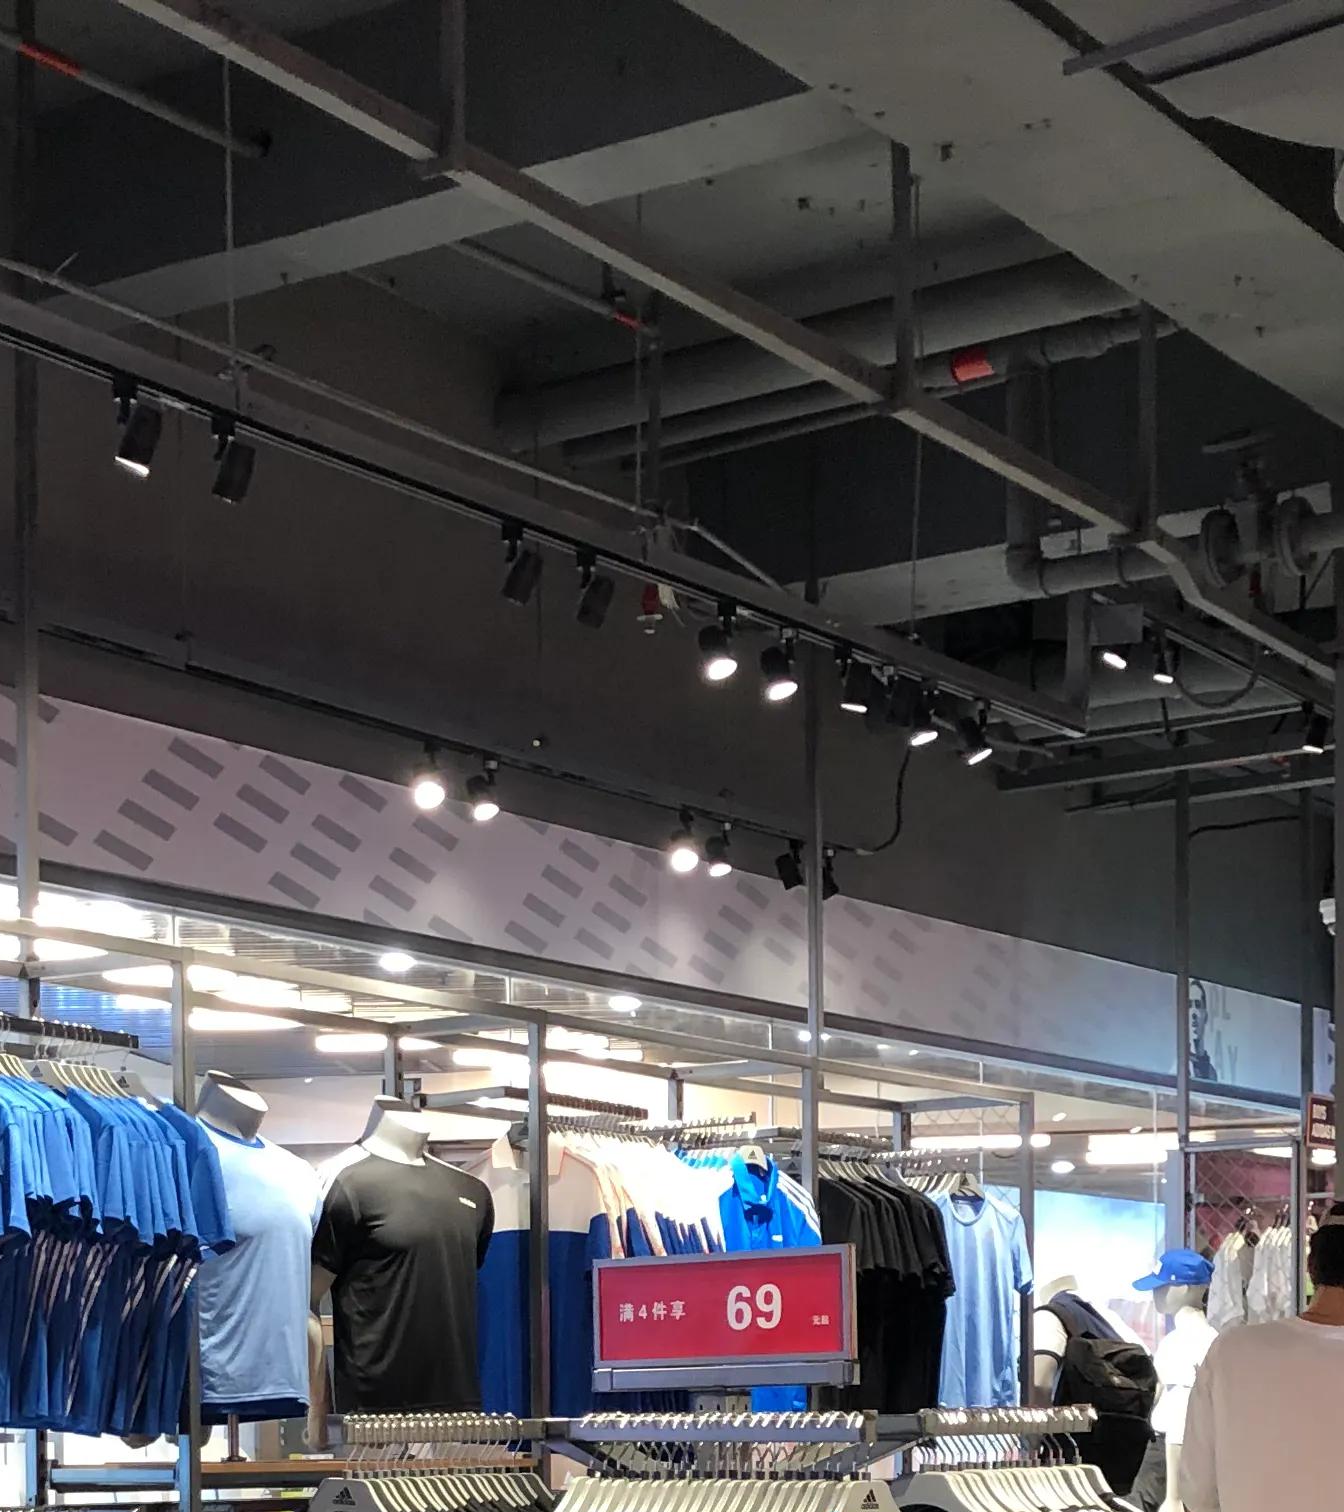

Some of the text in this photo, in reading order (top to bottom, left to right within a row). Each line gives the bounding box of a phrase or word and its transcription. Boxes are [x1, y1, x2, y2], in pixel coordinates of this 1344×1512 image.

[619, 1300, 686, 1322] 满4件享
[726, 1283, 782, 1331] 69
